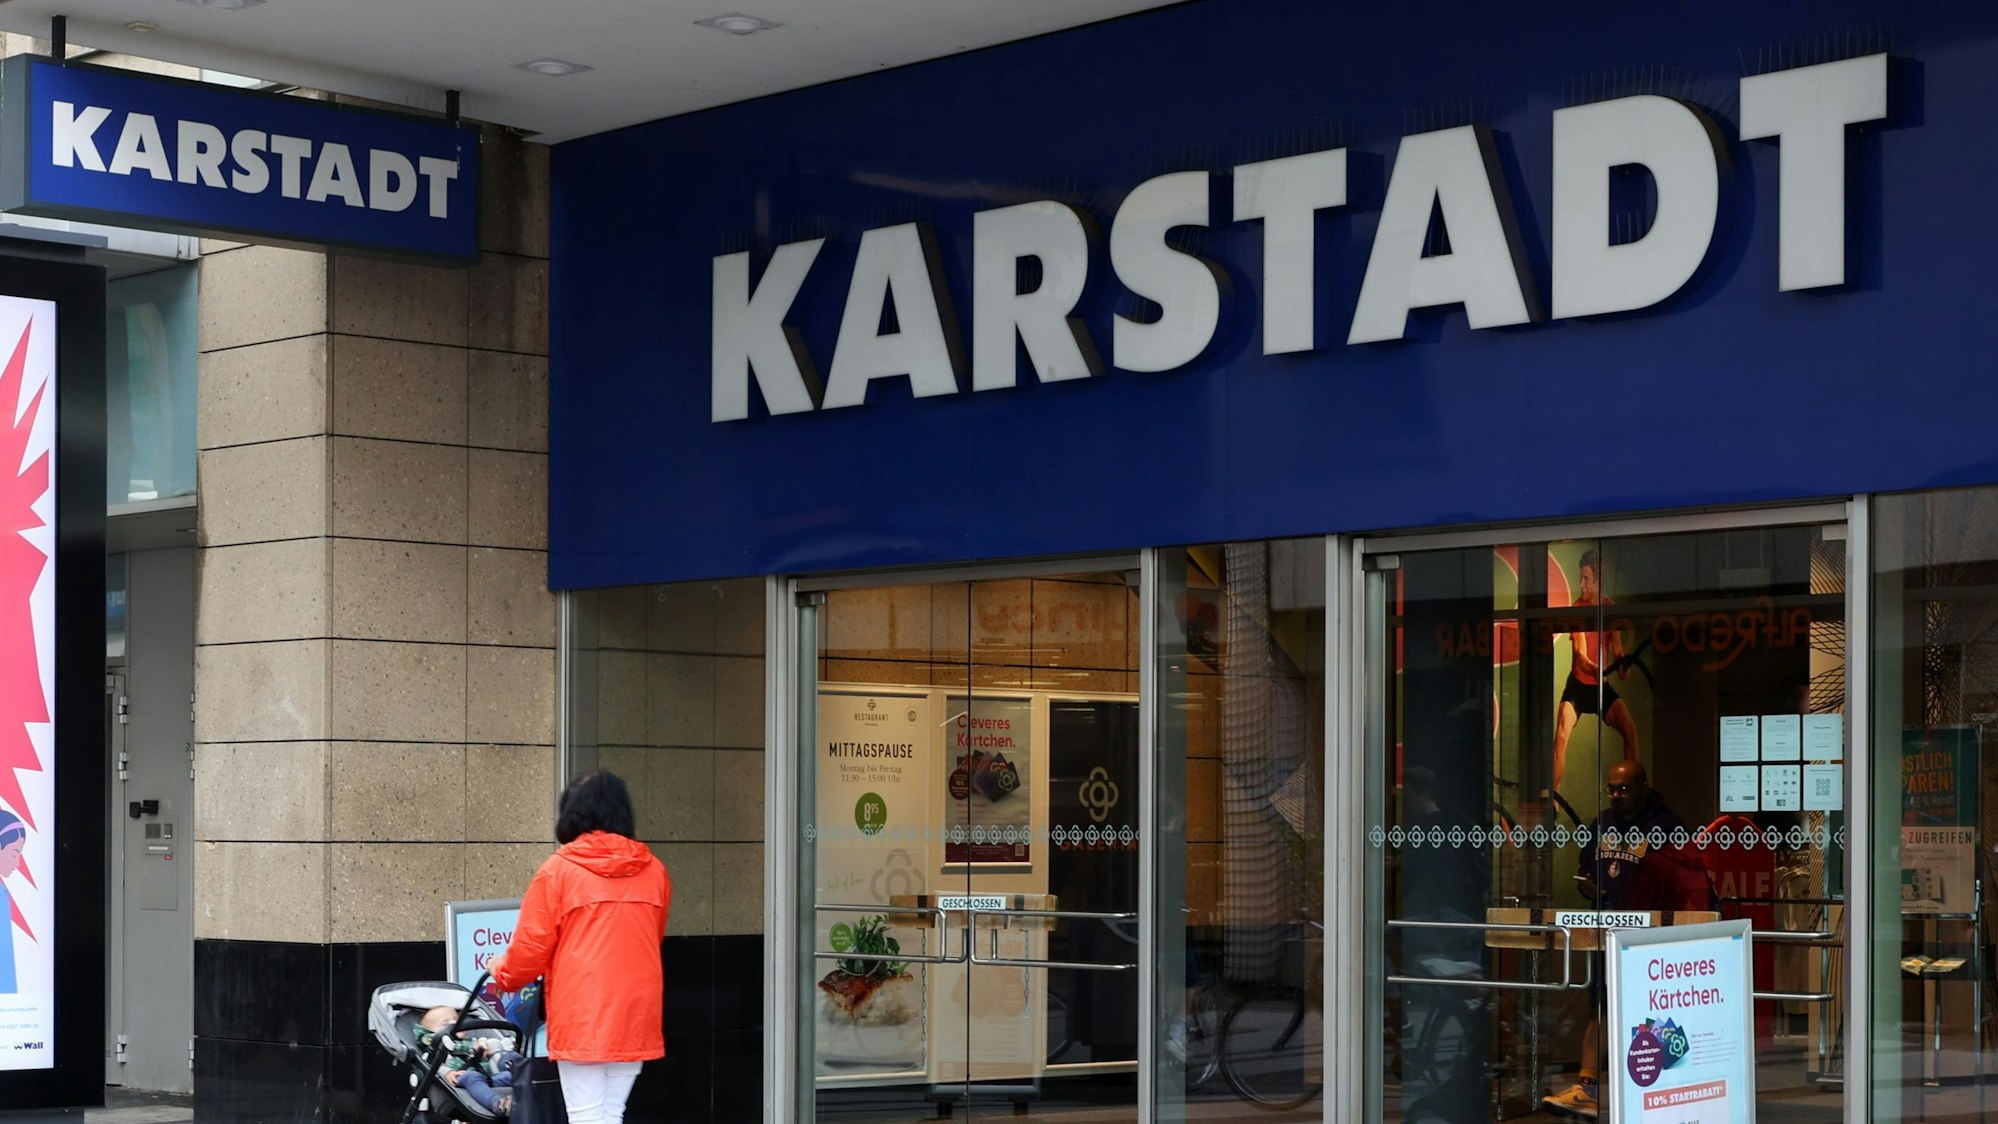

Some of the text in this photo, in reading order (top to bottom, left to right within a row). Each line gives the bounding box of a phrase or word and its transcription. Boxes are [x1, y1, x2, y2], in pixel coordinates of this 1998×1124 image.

[52, 100, 461, 218] KARSTADT
[711, 54, 1888, 423] KARSTADT
[854, 713, 889, 721] RESTAURANT
[957, 715, 1010, 729] Ceveres
[829, 742, 913, 759] MITTAGSPAUSE
[840, 764, 865, 774] Montag
[879, 765, 903, 774] Freitag
[888, 775, 902, 783] Uhr
[1908, 831, 1972, 844] ZUGREIFEN
[942, 898, 1002, 909] GESCHLOSSEN
[1562, 914, 1644, 927] GESCHLOSSEN
[473, 928, 515, 947] Clev
[1648, 958, 1716, 981] Cleveres
[1649, 985, 1724, 1011] Kärtchen.
[23, 1041, 44, 1050] Wall
[1648, 1095, 1668, 1107] 10%
